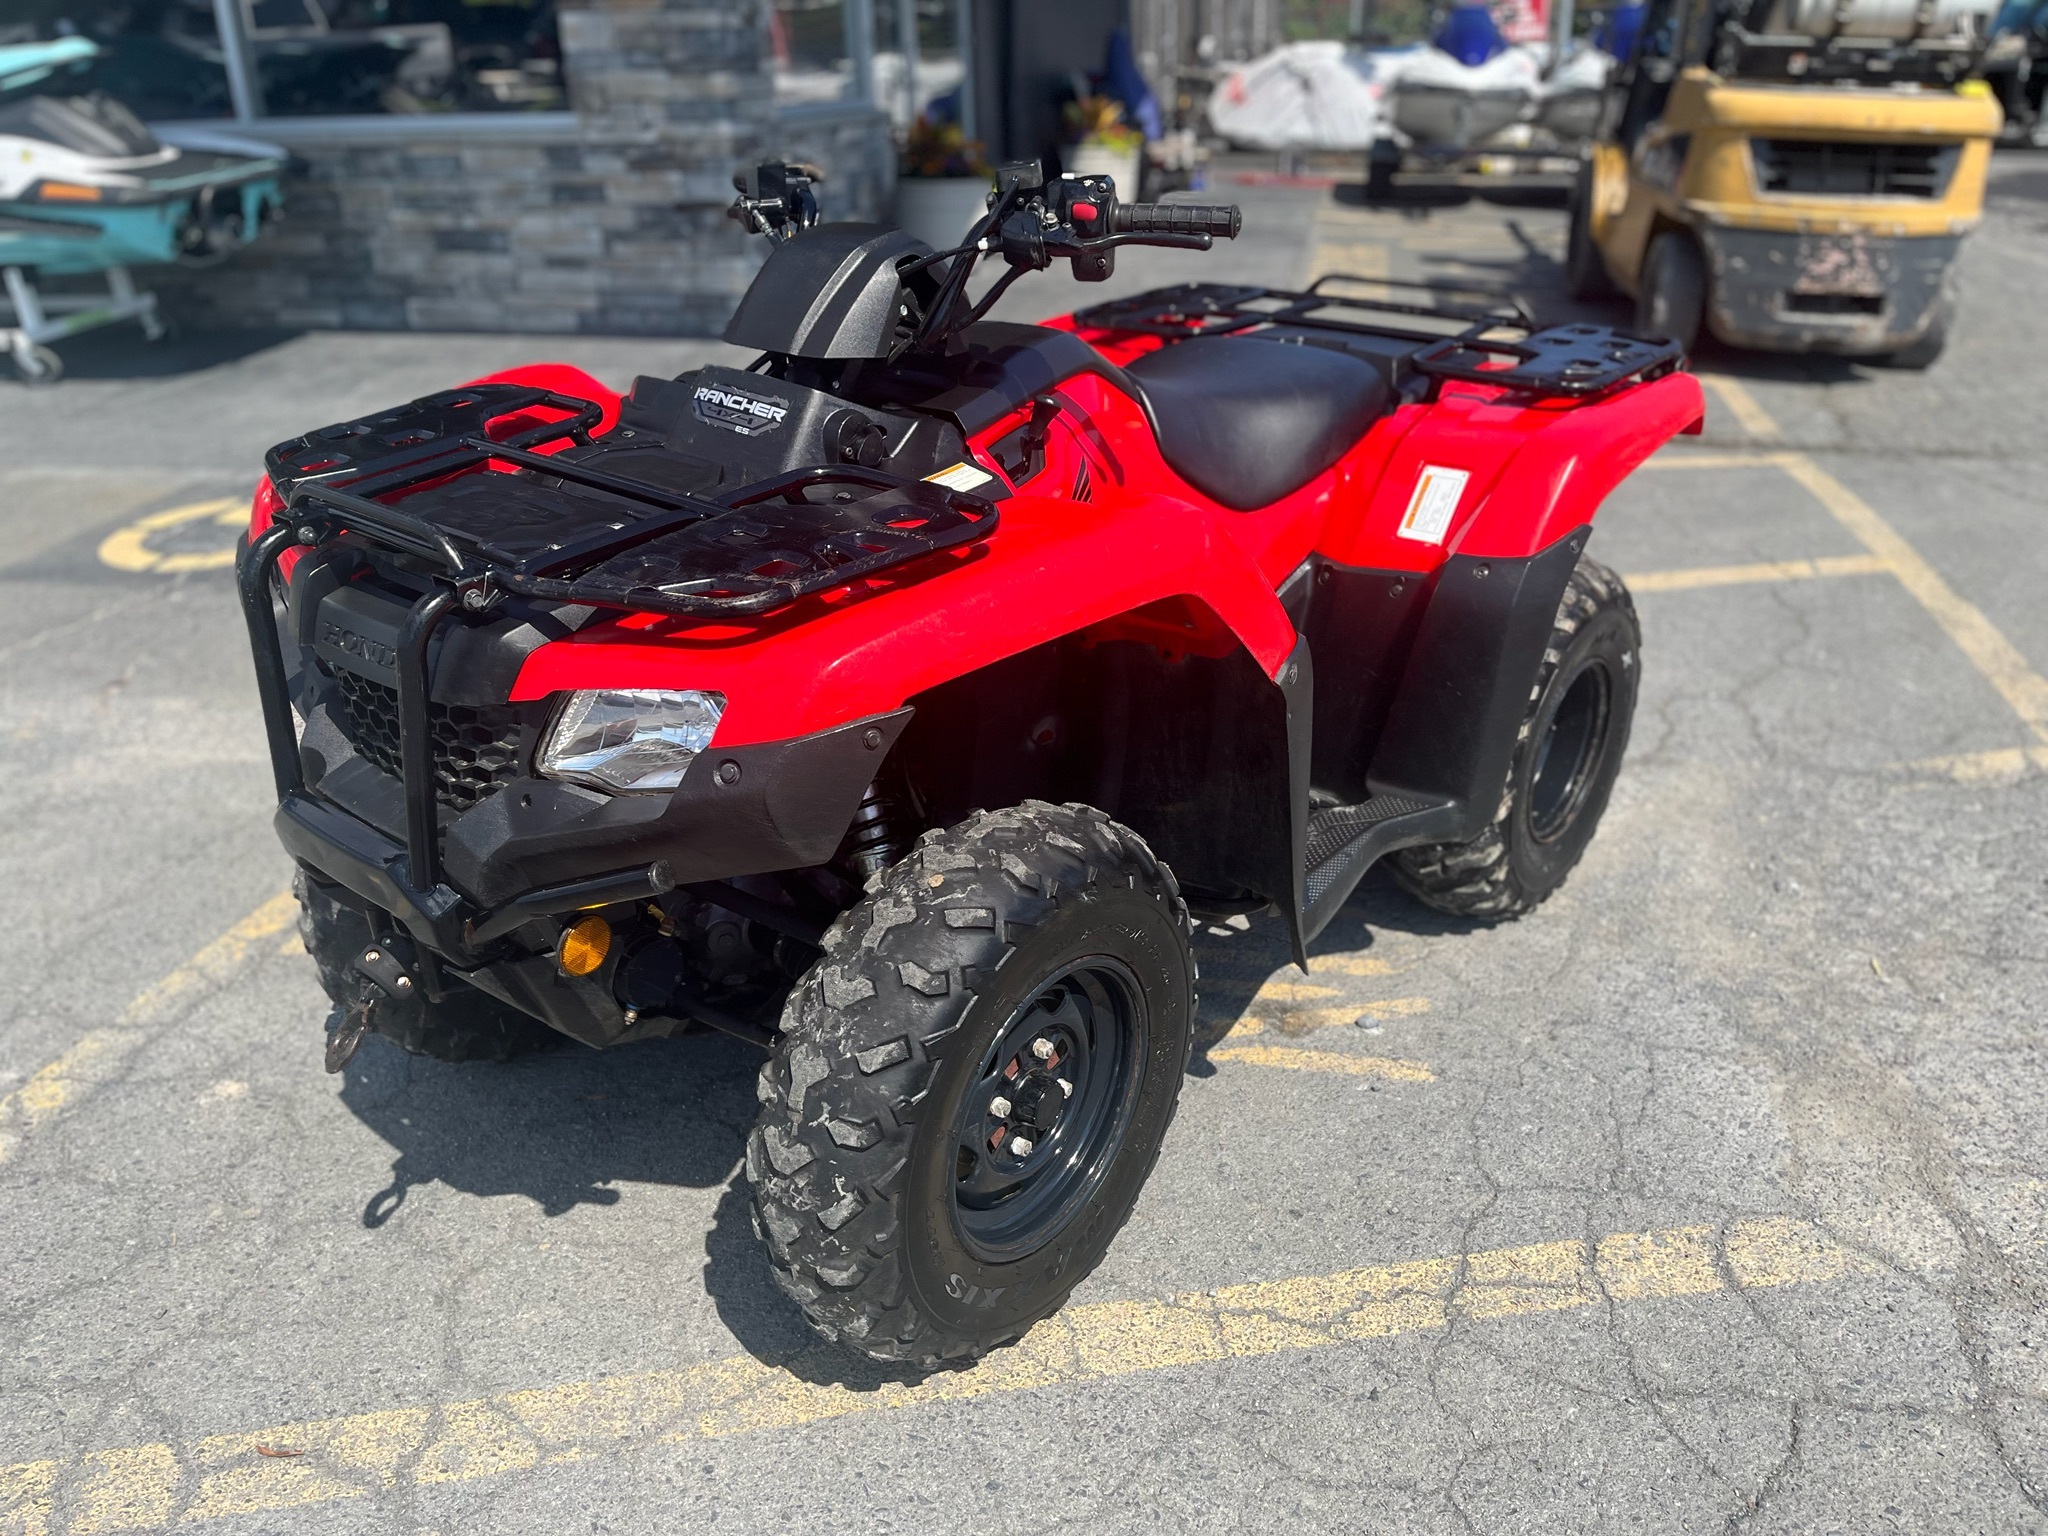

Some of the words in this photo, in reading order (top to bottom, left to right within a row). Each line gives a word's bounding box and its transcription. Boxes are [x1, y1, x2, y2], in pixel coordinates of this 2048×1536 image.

[693, 387, 788, 423] RANCHER
[734, 425, 750, 435] ES
[322, 621, 398, 670] HOND
